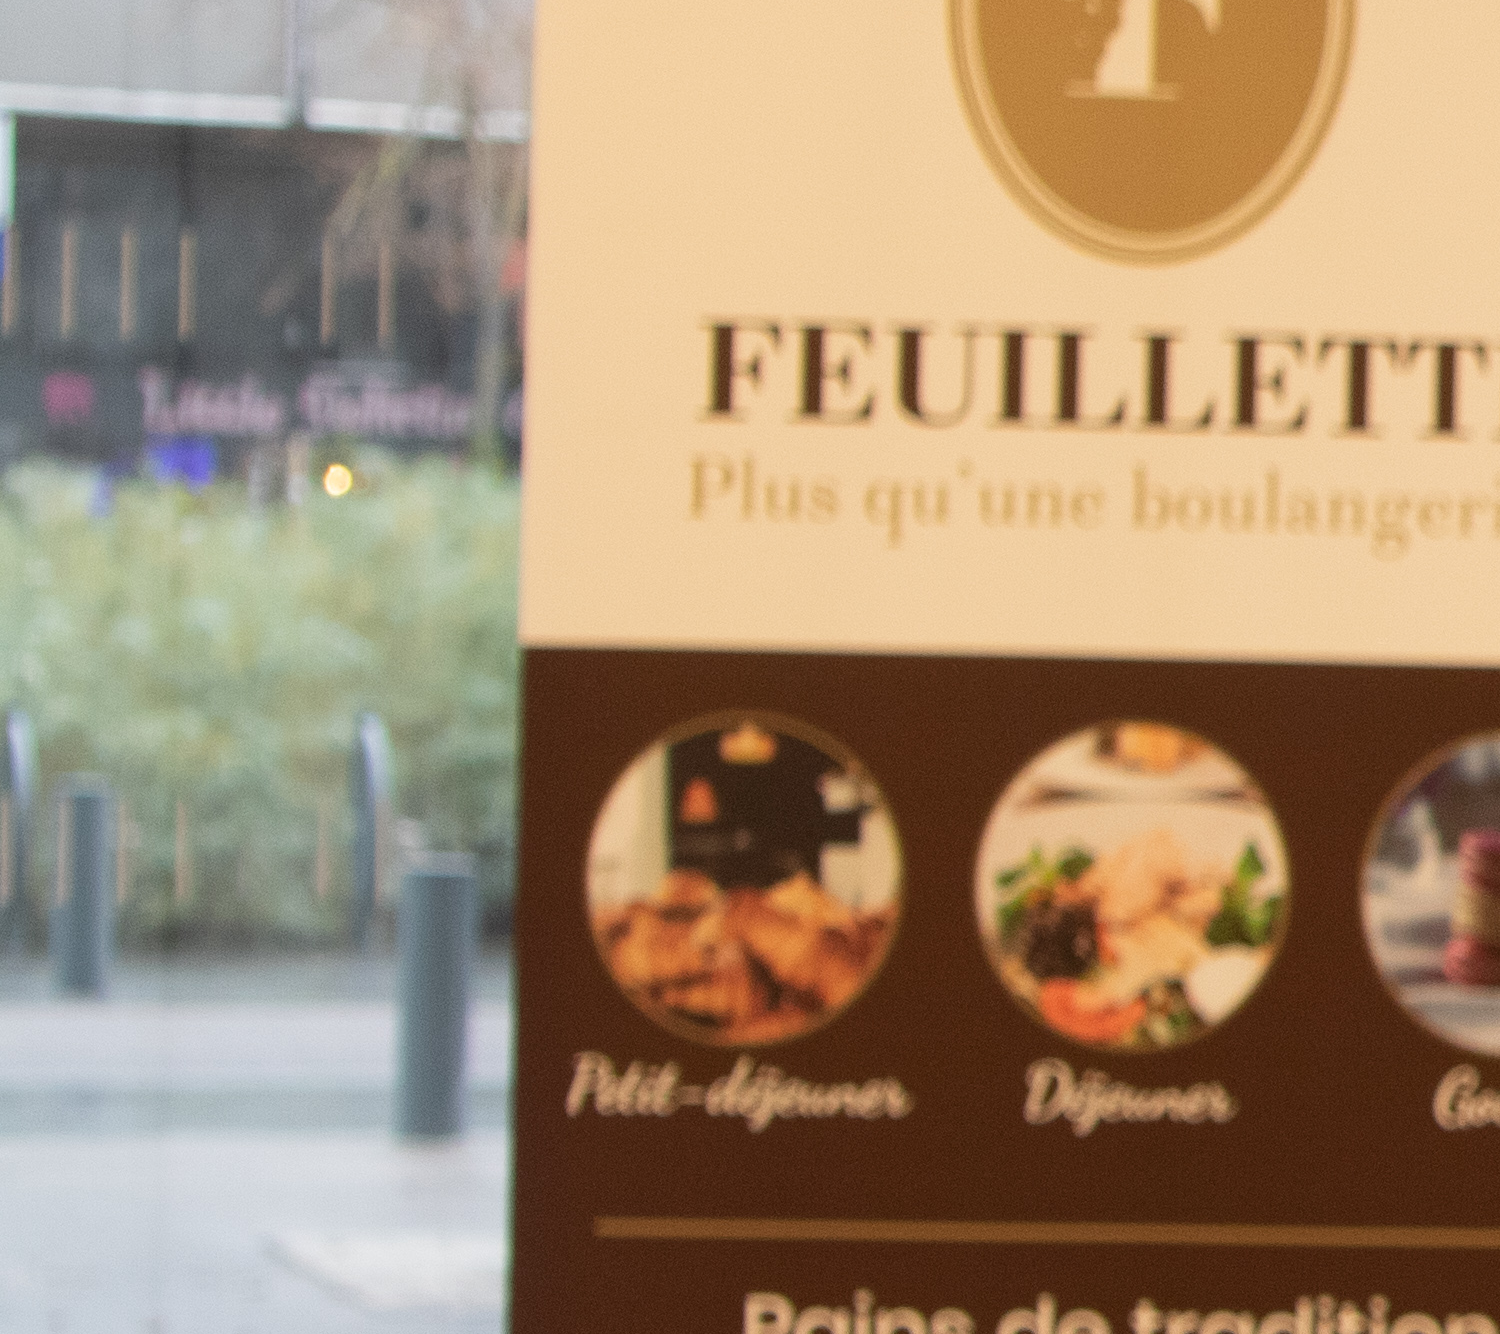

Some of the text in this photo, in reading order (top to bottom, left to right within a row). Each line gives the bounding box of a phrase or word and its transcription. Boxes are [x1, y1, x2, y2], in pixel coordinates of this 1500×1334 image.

[688, 452, 842, 523] Plus
[860, 461, 1106, 547] qu'une
[564, 1050, 912, 1133] Petit-déjeuner
[1022, 1058, 1236, 1137] Déjeuner
